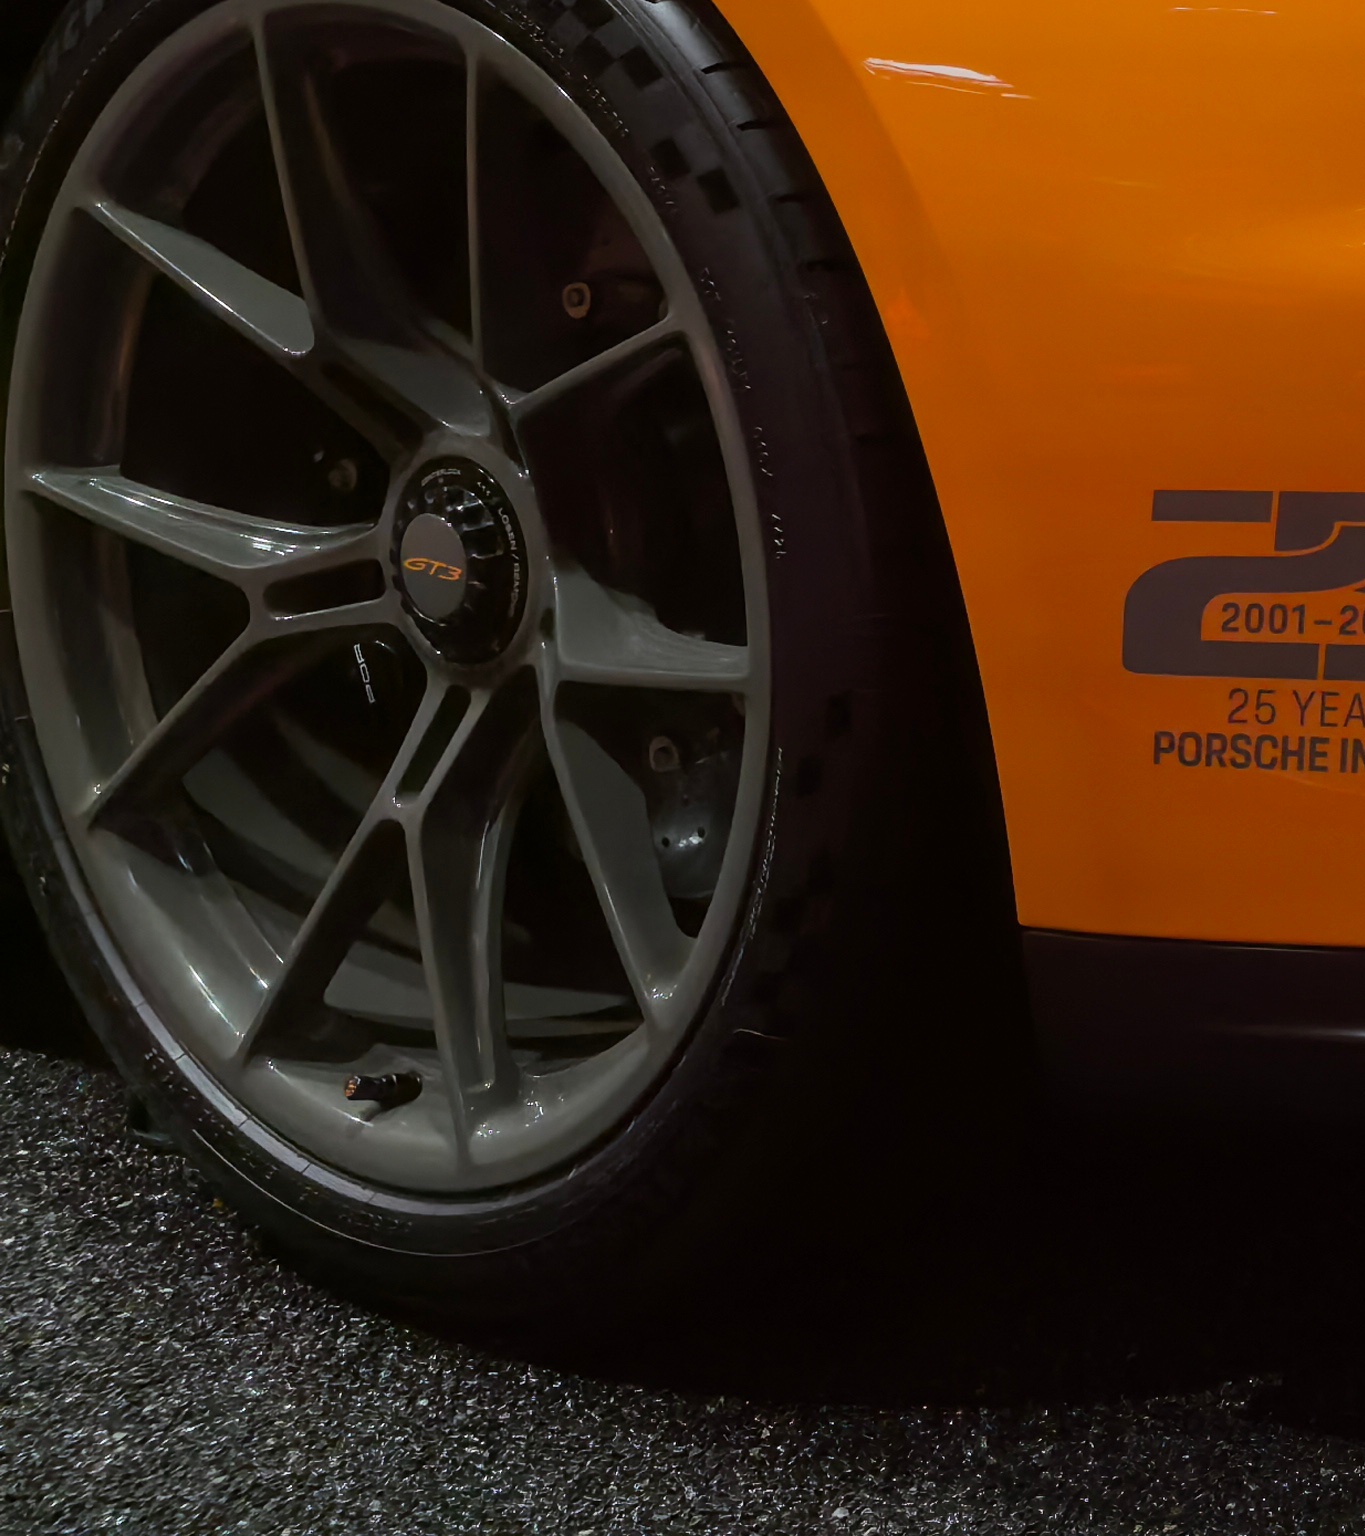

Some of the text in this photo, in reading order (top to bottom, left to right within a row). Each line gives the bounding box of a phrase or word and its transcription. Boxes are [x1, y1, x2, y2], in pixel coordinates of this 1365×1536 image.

[403, 557, 463, 582] GT3
[1227, 688, 1277, 725] 25
[1153, 731, 1329, 772] PORSCHE
